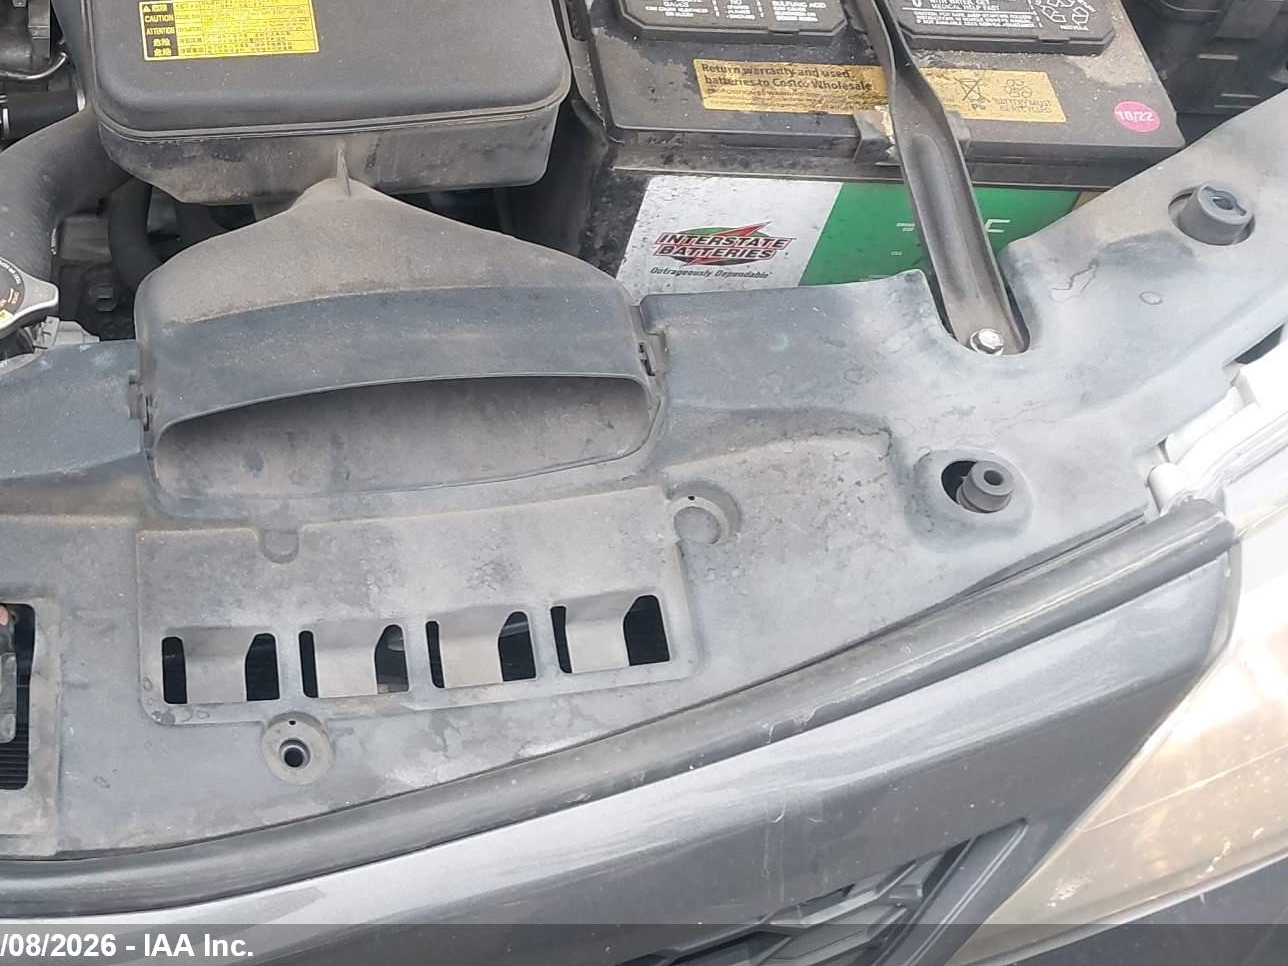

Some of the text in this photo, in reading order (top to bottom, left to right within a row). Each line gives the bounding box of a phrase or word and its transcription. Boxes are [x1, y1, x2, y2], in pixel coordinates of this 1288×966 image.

[144, 14, 174, 23] CAUTION
[146, 26, 175, 36] ATTENTION
[701, 64, 740, 74] Return
[743, 67, 796, 78] warranty
[798, 68, 820, 78] and
[705, 76, 872, 91] batteries to Costco Wholesale
[660, 233, 789, 248] INTERSTATE
[658, 246, 774, 259] BATTERIES
[650, 266, 770, 279] Outrageously Dependable
